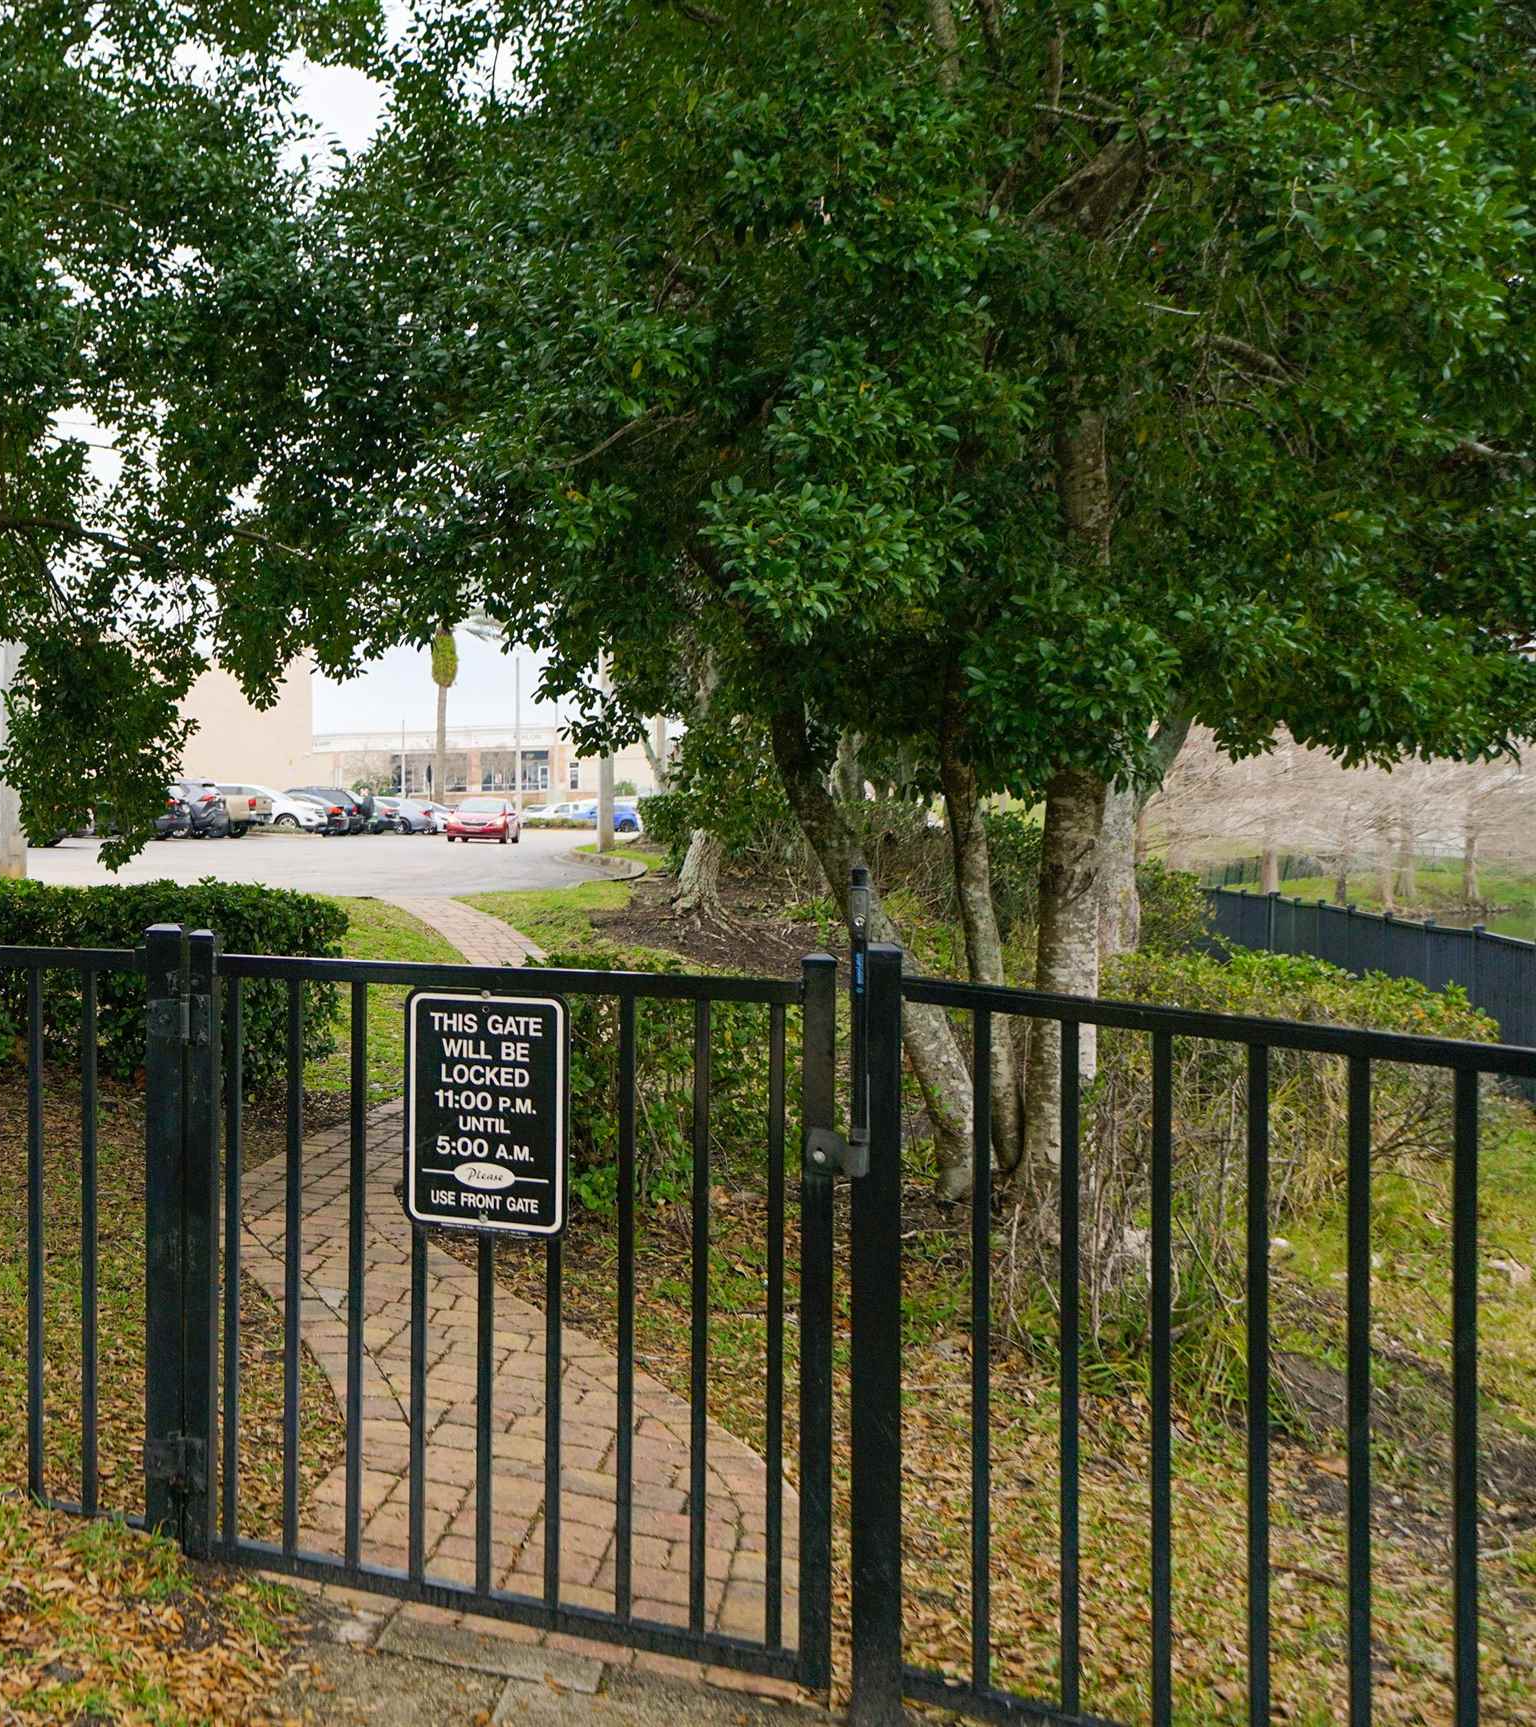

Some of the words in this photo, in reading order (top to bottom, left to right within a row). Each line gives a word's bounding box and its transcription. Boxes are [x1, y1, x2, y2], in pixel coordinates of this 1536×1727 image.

[430, 1012, 478, 1033] THIS
[487, 1014, 543, 1037] GATE
[442, 1038, 492, 1060] WILL
[500, 1041, 530, 1063] BE
[441, 1063, 530, 1088] LOCKED
[434, 1088, 493, 1111] 11:00
[498, 1096, 537, 1115] P.M.
[458, 1115, 511, 1135] UNTIL
[436, 1135, 489, 1158] 5:00
[495, 1143, 535, 1162] A.M.
[465, 1167, 504, 1181] Please
[431, 1189, 456, 1206] USE
[460, 1192, 503, 1210] FRONT
[506, 1196, 539, 1214] GATE
